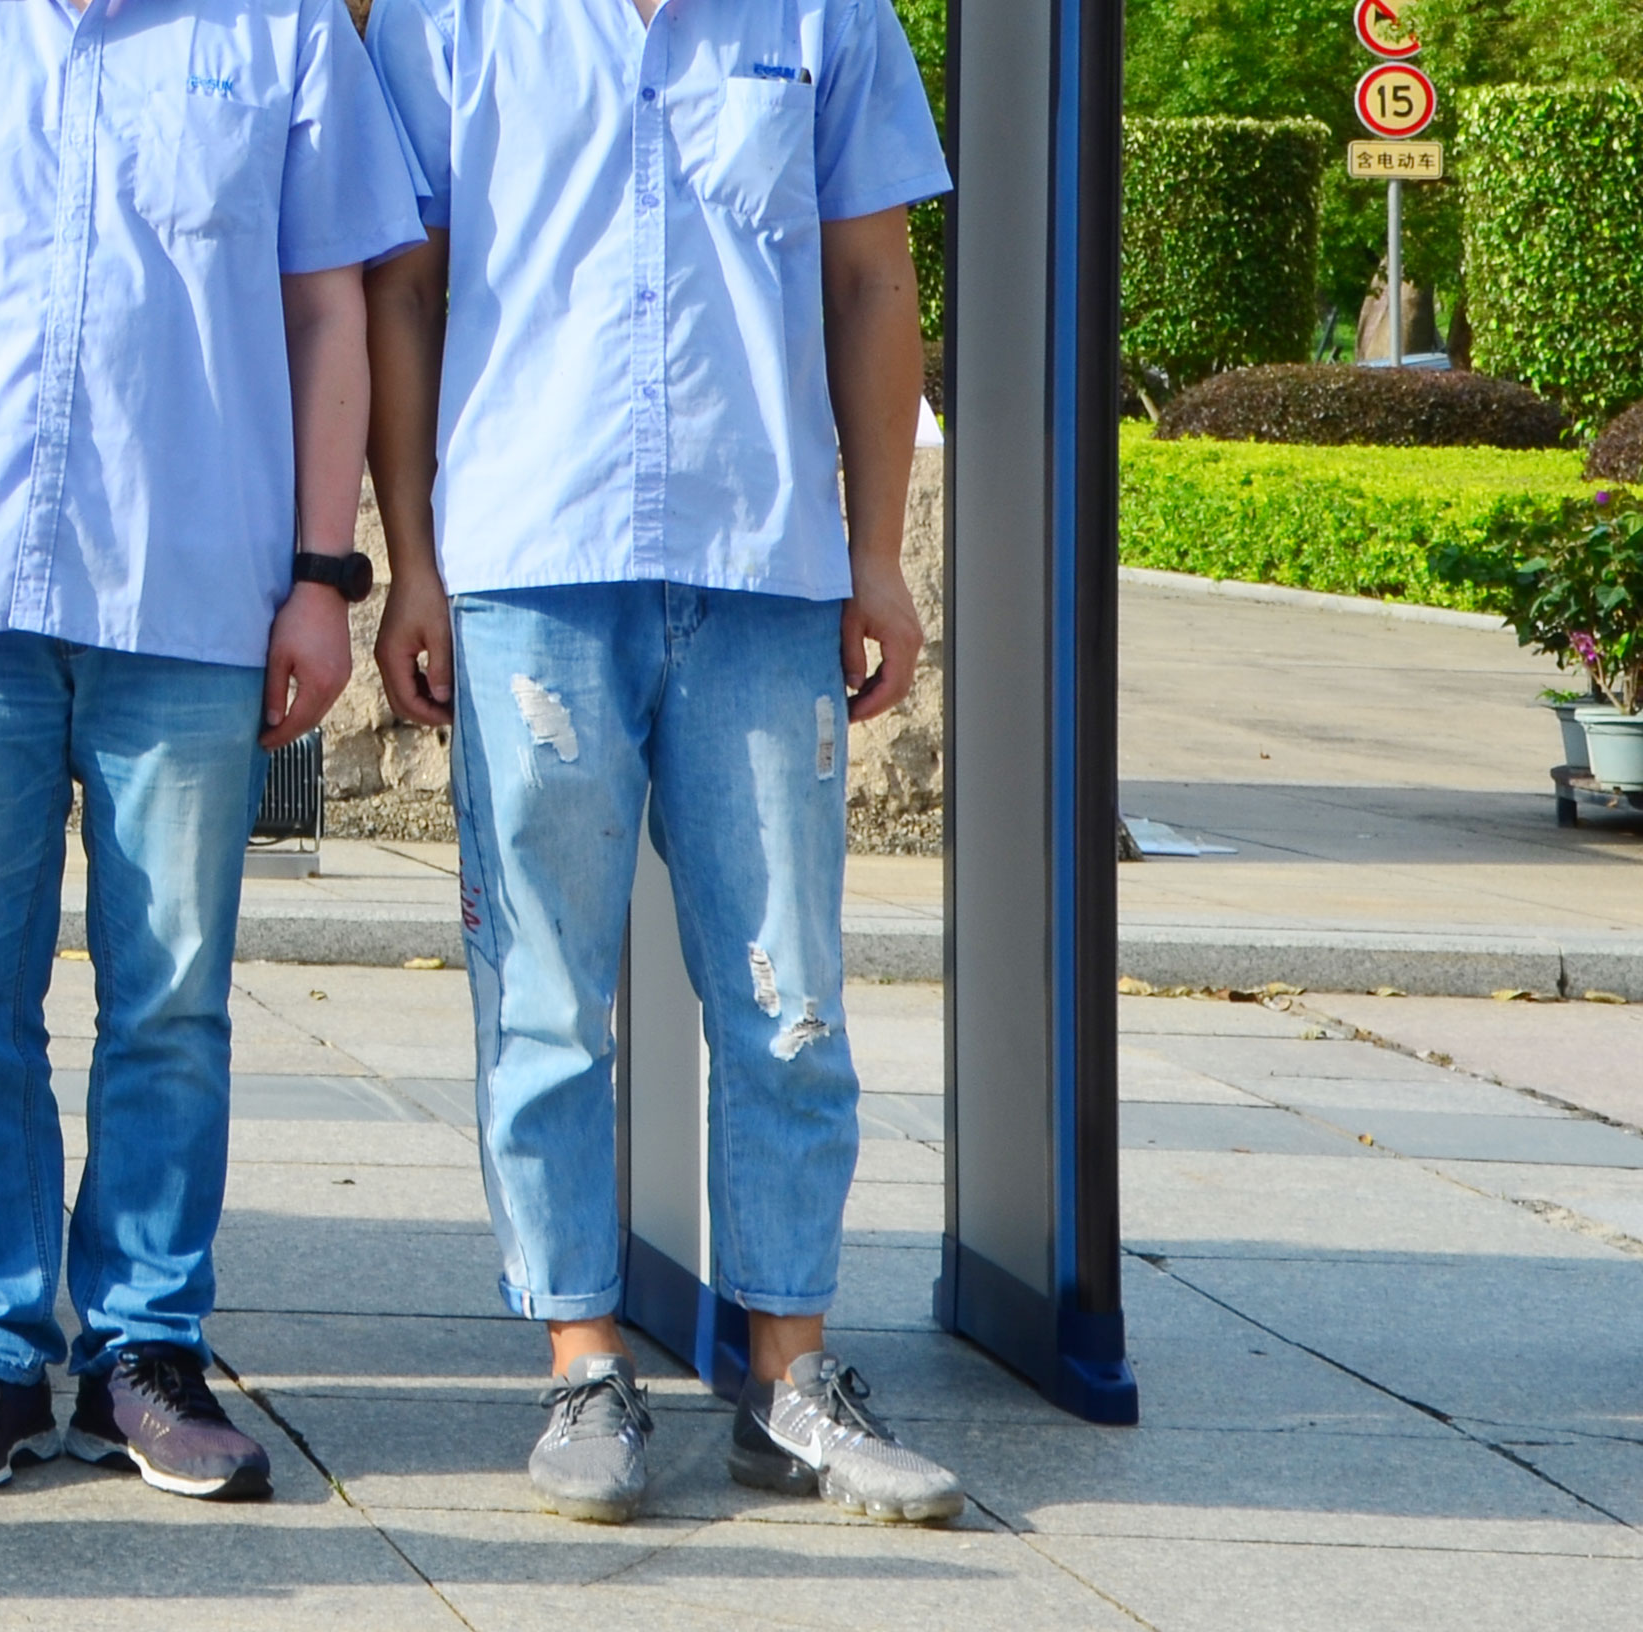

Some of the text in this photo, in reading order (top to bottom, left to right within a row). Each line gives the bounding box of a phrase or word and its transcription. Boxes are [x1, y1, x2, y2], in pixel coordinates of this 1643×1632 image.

[1377, 85, 1414, 118] 15
[1357, 151, 1436, 170] 含电动车
